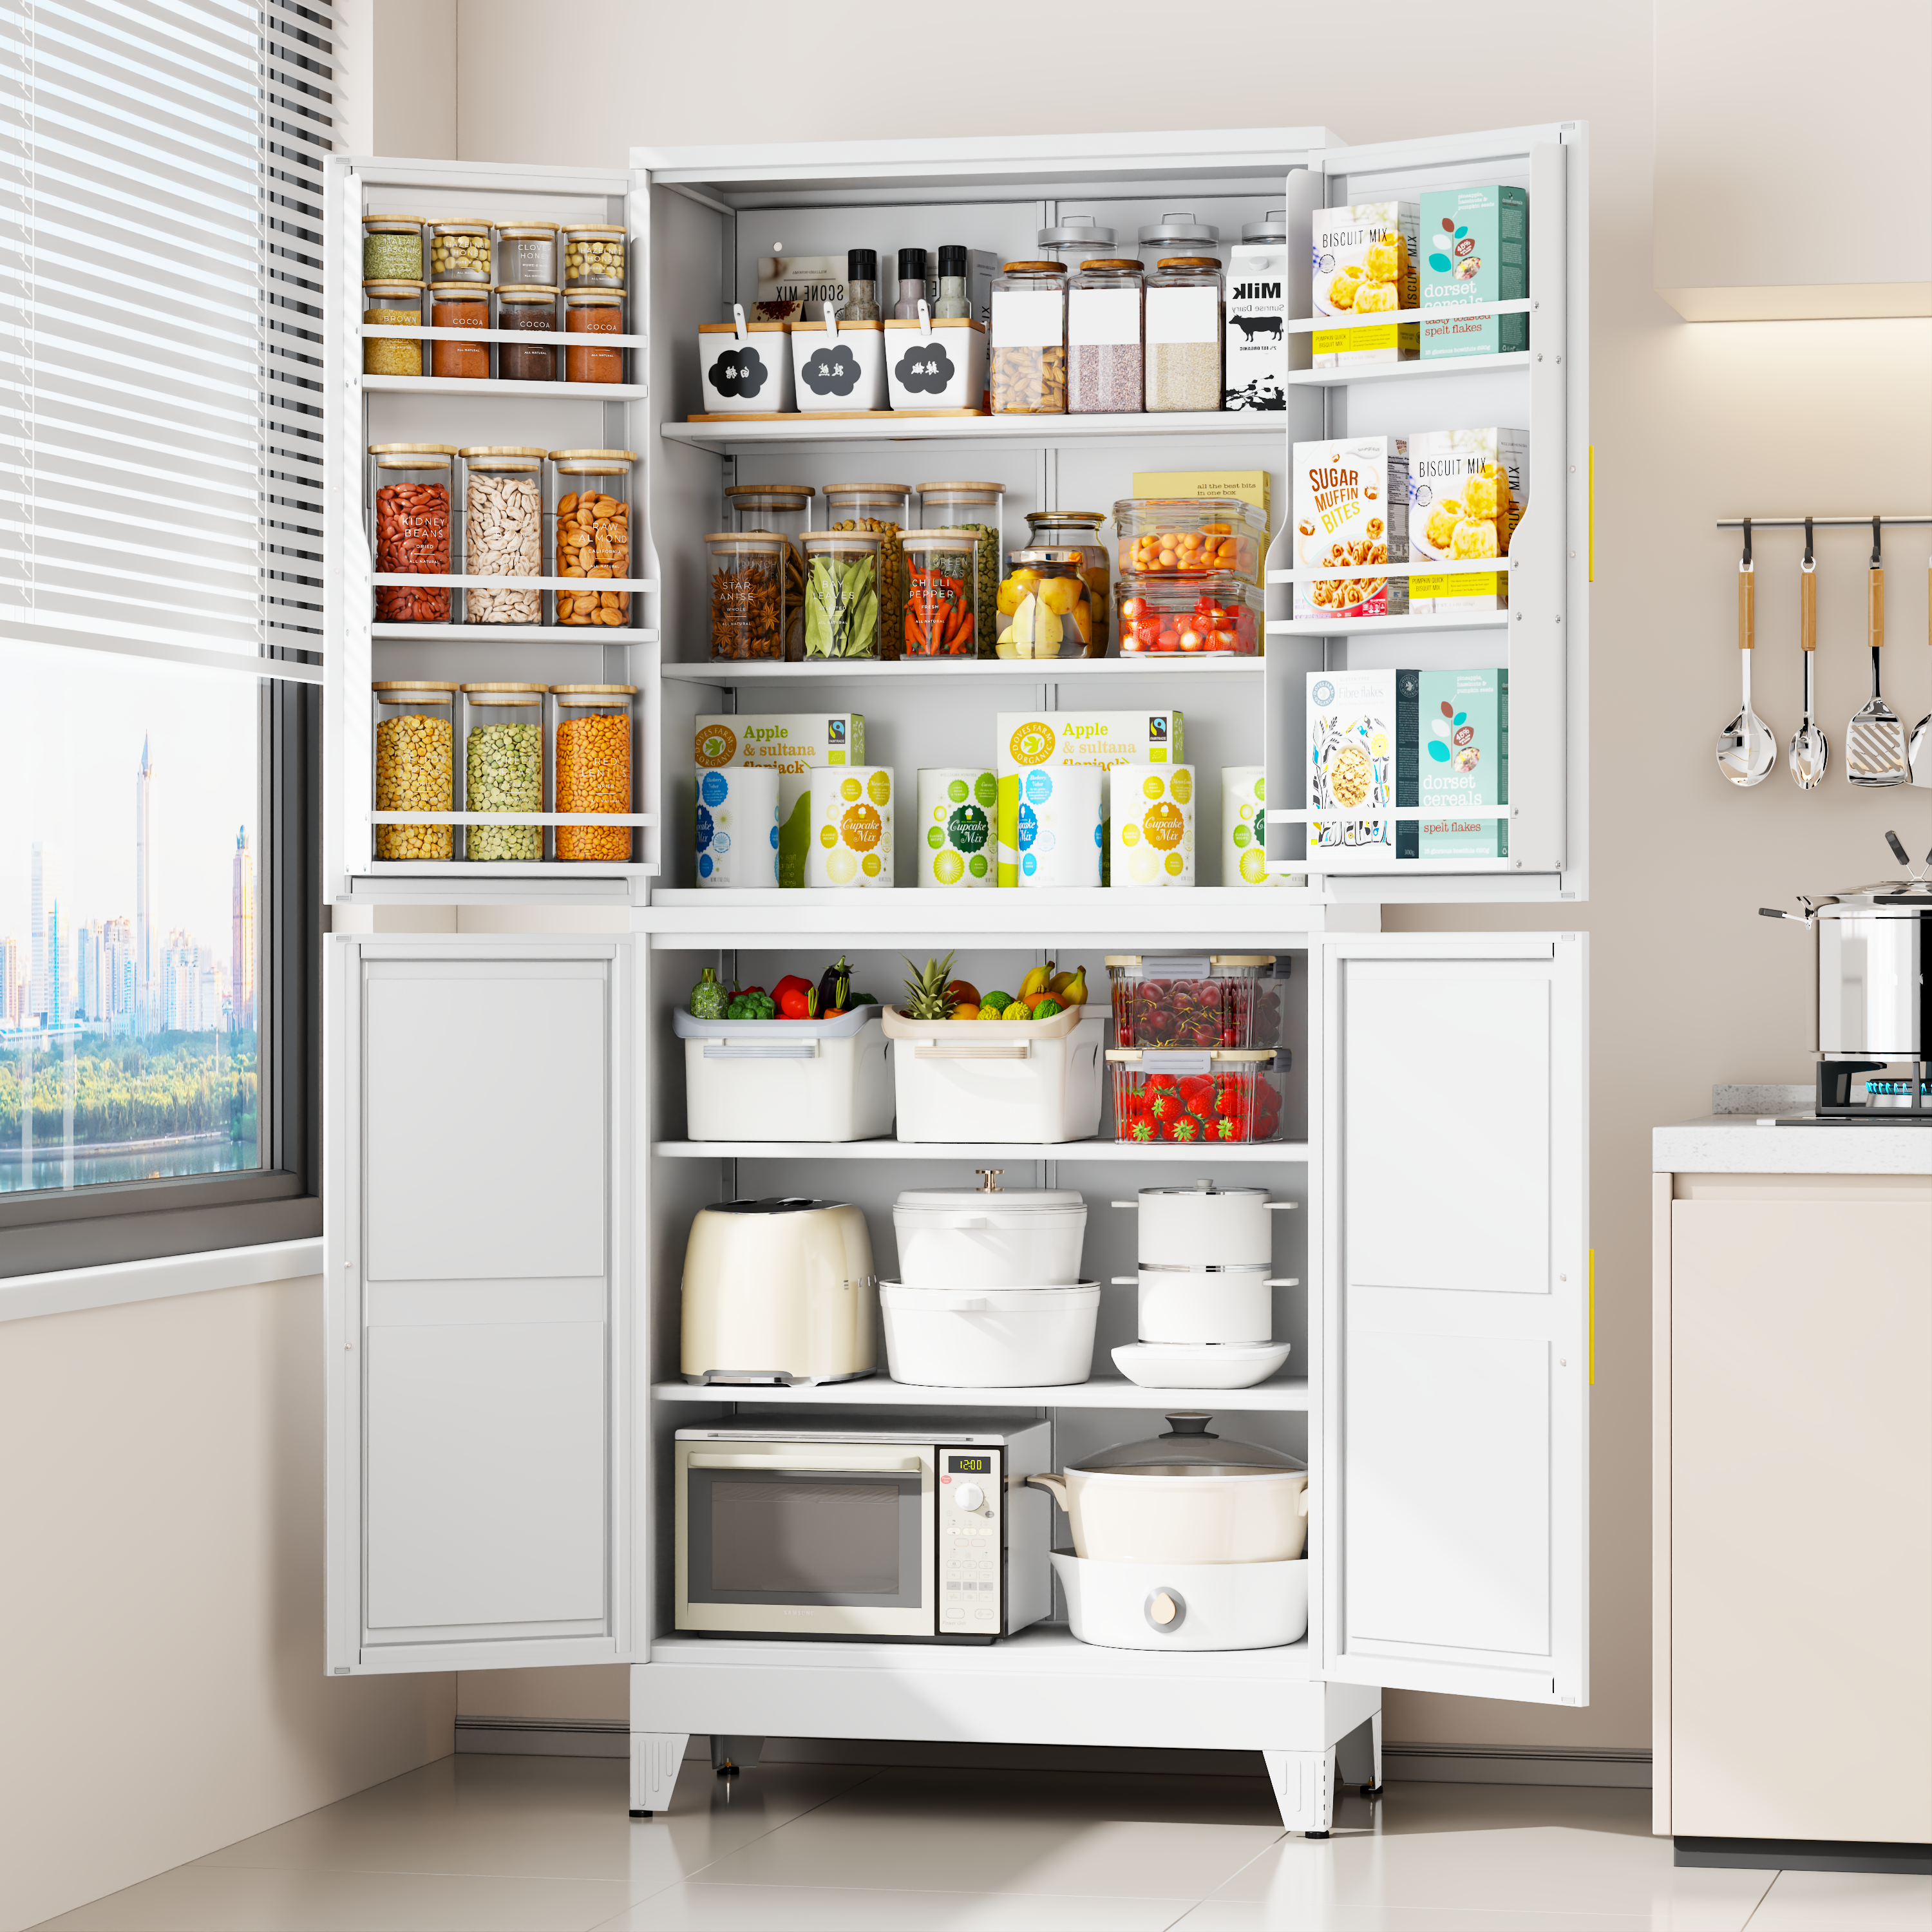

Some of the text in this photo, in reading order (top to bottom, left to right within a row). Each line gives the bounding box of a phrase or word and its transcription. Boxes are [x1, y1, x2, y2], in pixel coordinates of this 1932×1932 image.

[1323, 227, 1387, 247] BISCUIT MIX
[446, 241, 488, 249] HAZELNUT
[1407, 235, 1417, 257] MIX
[1457, 240, 1471, 252] 45%
[1425, 280, 1477, 298] dorset
[1425, 296, 1482, 308] cereals
[1425, 326, 1450, 337] spelt
[1452, 324, 1482, 334] flakes
[1419, 458, 1486, 477] BISCUIT MIX
[1309, 468, 1358, 492] SUGAR
[1314, 488, 1358, 513] MUFFIN
[402, 517, 445, 527] KIDNEY
[1321, 501, 1360, 534] BITES
[497, 520, 532, 529] PINTO
[592, 522, 618, 531] RAW
[404, 529, 443, 538] BEANS
[495, 531, 533, 540] BEANS
[578, 534, 627, 543] ALMOND
[933, 557, 967, 565] GREEN
[723, 582, 750, 590] STAR
[720, 592, 753, 601] ANISE
[813, 591, 855, 600] LEAVES
[909, 590, 953, 598] PEPPER
[1313, 681, 1334, 695] DOVES FARM
[1339, 686, 1383, 699] Fibre flakes
[1314, 697, 1334, 706] ORGANIC
[743, 725, 788, 742] Apple
[1012, 724, 1052, 751] DOVES FARM
[1063, 723, 1108, 739] Apple
[1456, 728, 1470, 741] 45%
[696, 728, 734, 754] DOVES FARM
[1063, 740, 1137, 753] & sultana
[743, 743, 816, 756] & sultana
[1017, 745, 1052, 764] ORGANIC
[401, 755, 447, 764] YELLOW
[495, 756, 535, 764] GREEN
[594, 757, 618, 766] RED
[699, 747, 734, 766] ORGANIC
[411, 767, 440, 775] PEAS
[502, 768, 531, 776] PEAS
[582, 769, 627, 778] LENTILS
[1423, 774, 1475, 790] dorset
[1423, 791, 1482, 806] cereals
[842, 818, 880, 833] Cupcake
[950, 819, 987, 833] Cupcake
[1145, 817, 1182, 831] Cupcake
[1424, 822, 1481, 835] spelt flakes
[853, 830, 876, 842] Mix
[960, 831, 983, 844] Mix
[1019, 830, 1032, 842] Mix
[1156, 829, 1179, 841] Mix
[960, 1459, 982, 1470] 12:00
